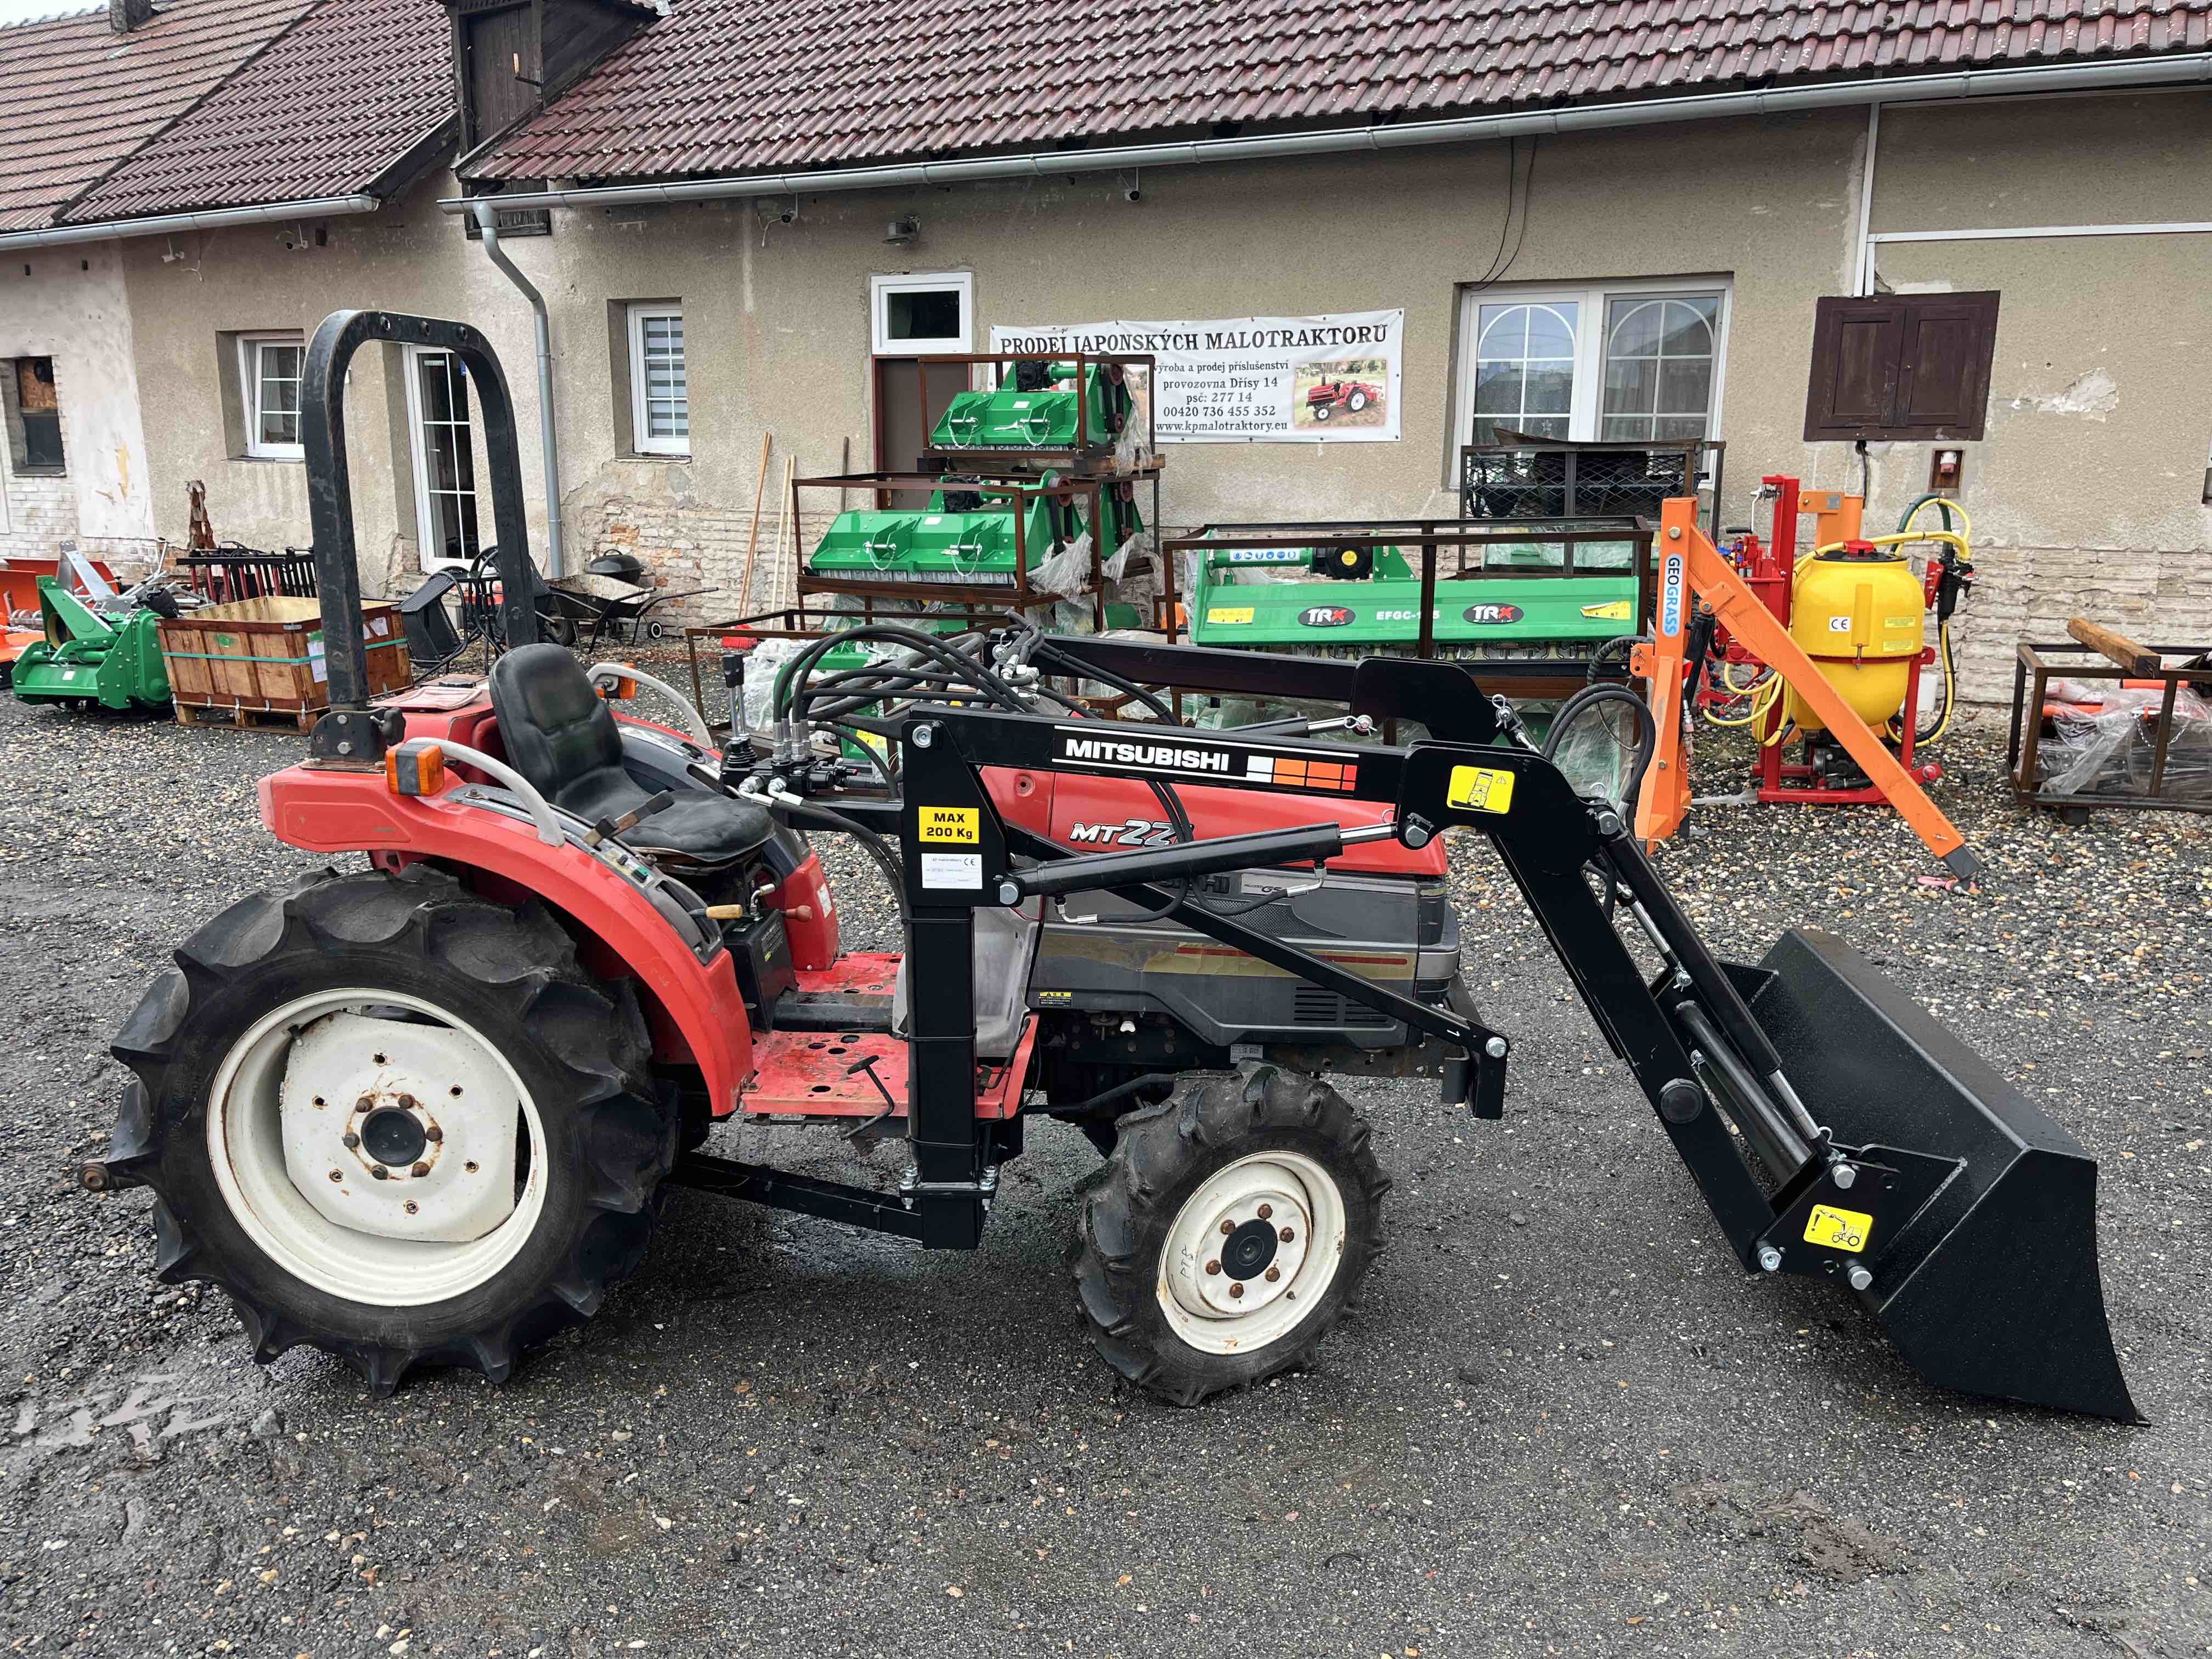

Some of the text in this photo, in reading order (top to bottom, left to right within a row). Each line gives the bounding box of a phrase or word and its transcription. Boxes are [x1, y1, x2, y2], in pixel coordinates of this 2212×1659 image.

[1001, 324, 1387, 354] PRODEJ JAPONSKÝCH MALOTRAKTORŮ
[1197, 362, 1225, 374] prodej
[1228, 359, 1289, 373] příslušenství
[1163, 376, 1278, 391] provozovna Dřísy 14
[1186, 392, 1252, 405] psč: 277 14
[1163, 405, 1276, 417] 00420 736 455 352
[1155, 420, 1288, 433] www.kpmalotraktory.eu
[1664, 557, 1680, 633] GEOGRASS
[1065, 738, 1229, 771] MITSUBISHI
[934, 812, 966, 823] MAX
[926, 827, 973, 839] 200 Kg
